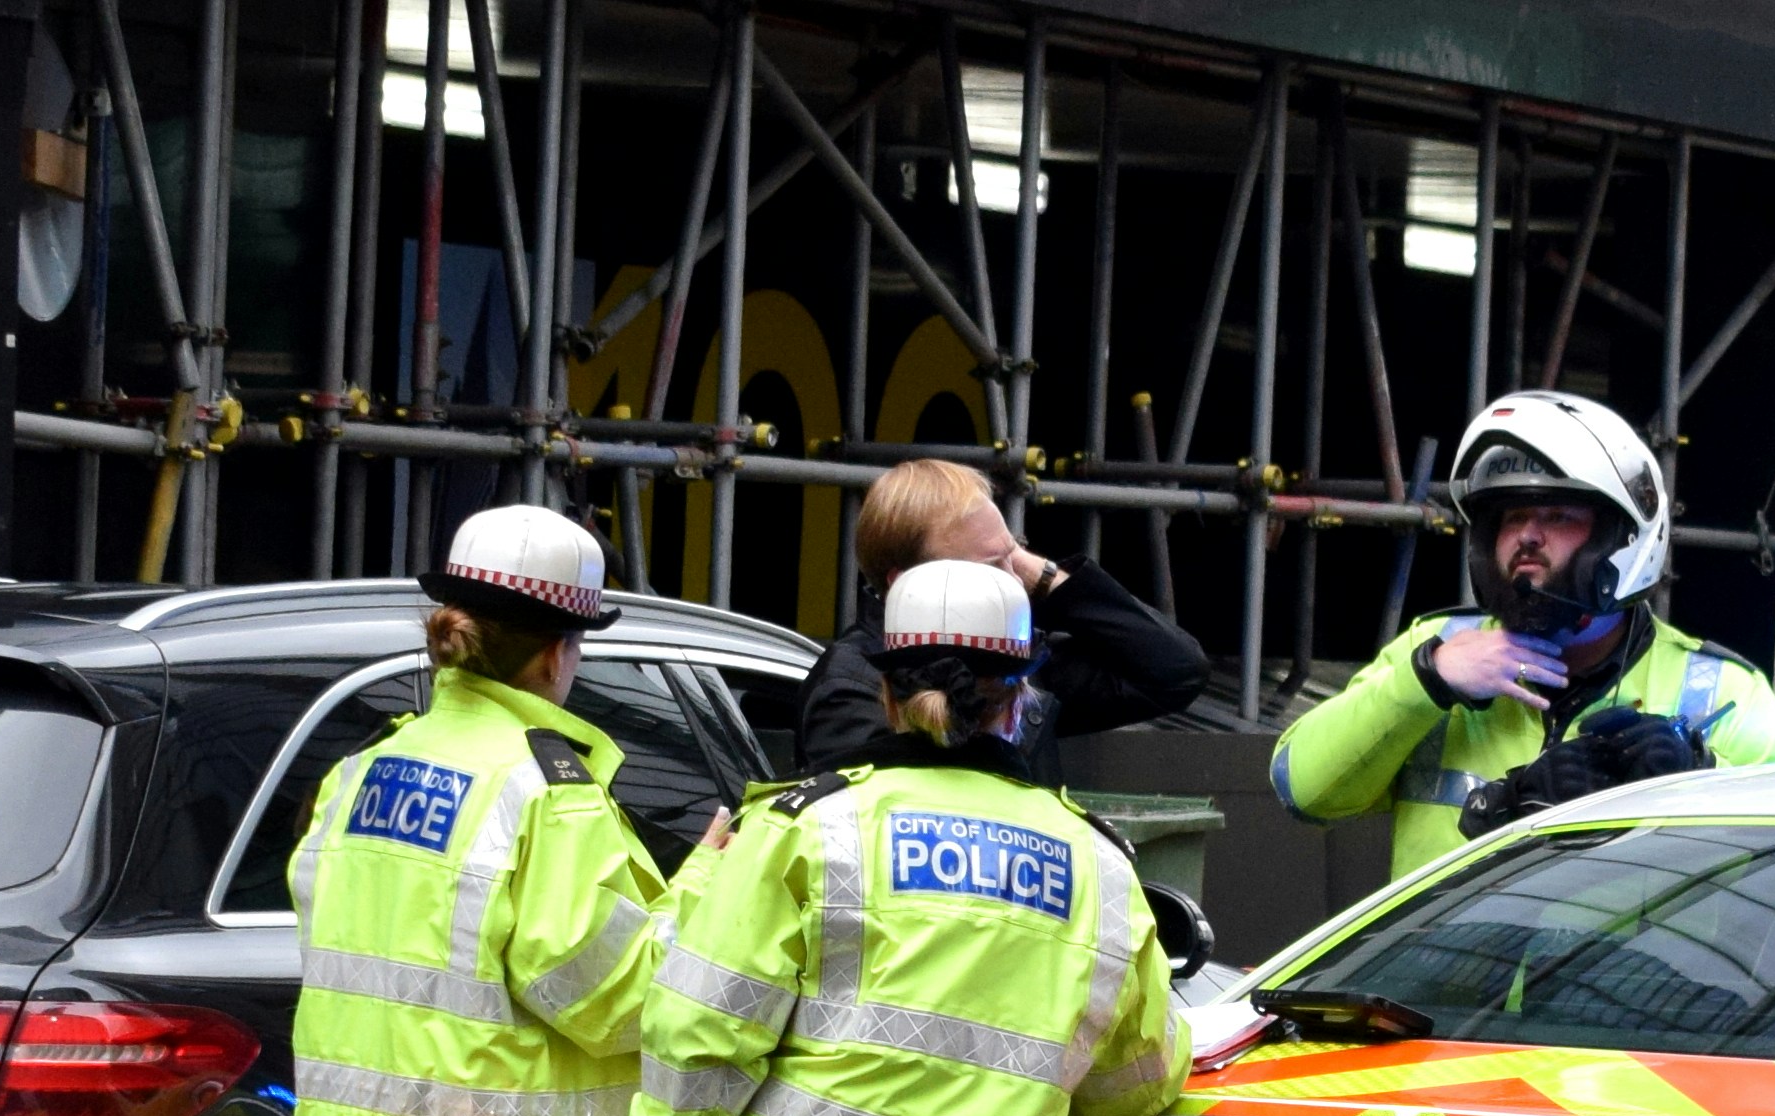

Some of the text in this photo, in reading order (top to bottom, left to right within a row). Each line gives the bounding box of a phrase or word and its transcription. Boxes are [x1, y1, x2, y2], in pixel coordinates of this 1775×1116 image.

[398, 764, 467, 795] LONDON
[895, 816, 1067, 863] CITY OF LONDON
[897, 838, 1066, 909] POLICE
